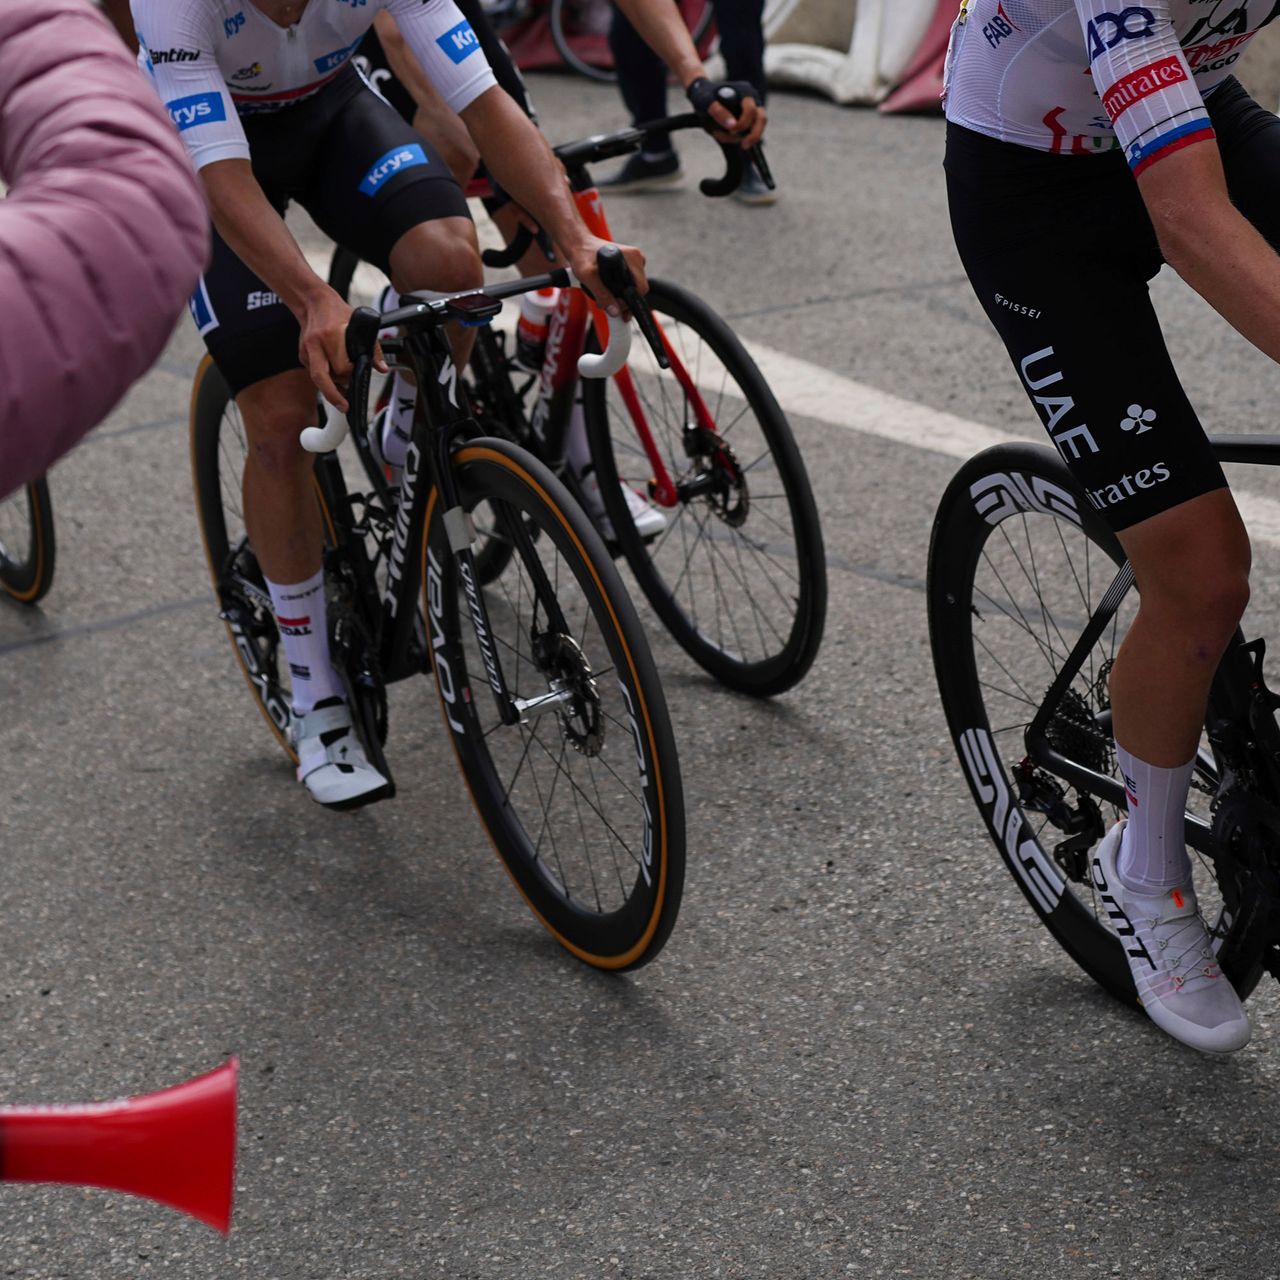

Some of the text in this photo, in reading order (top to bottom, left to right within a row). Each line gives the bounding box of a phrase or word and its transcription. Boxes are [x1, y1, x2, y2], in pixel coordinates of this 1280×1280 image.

[451, 26, 481, 51] Kry
[982, 15, 1014, 50] FAB
[368, 150, 414, 186] Krys
[1000, 298, 1042, 320] PISSEI
[1020, 345, 1100, 464] UAE
